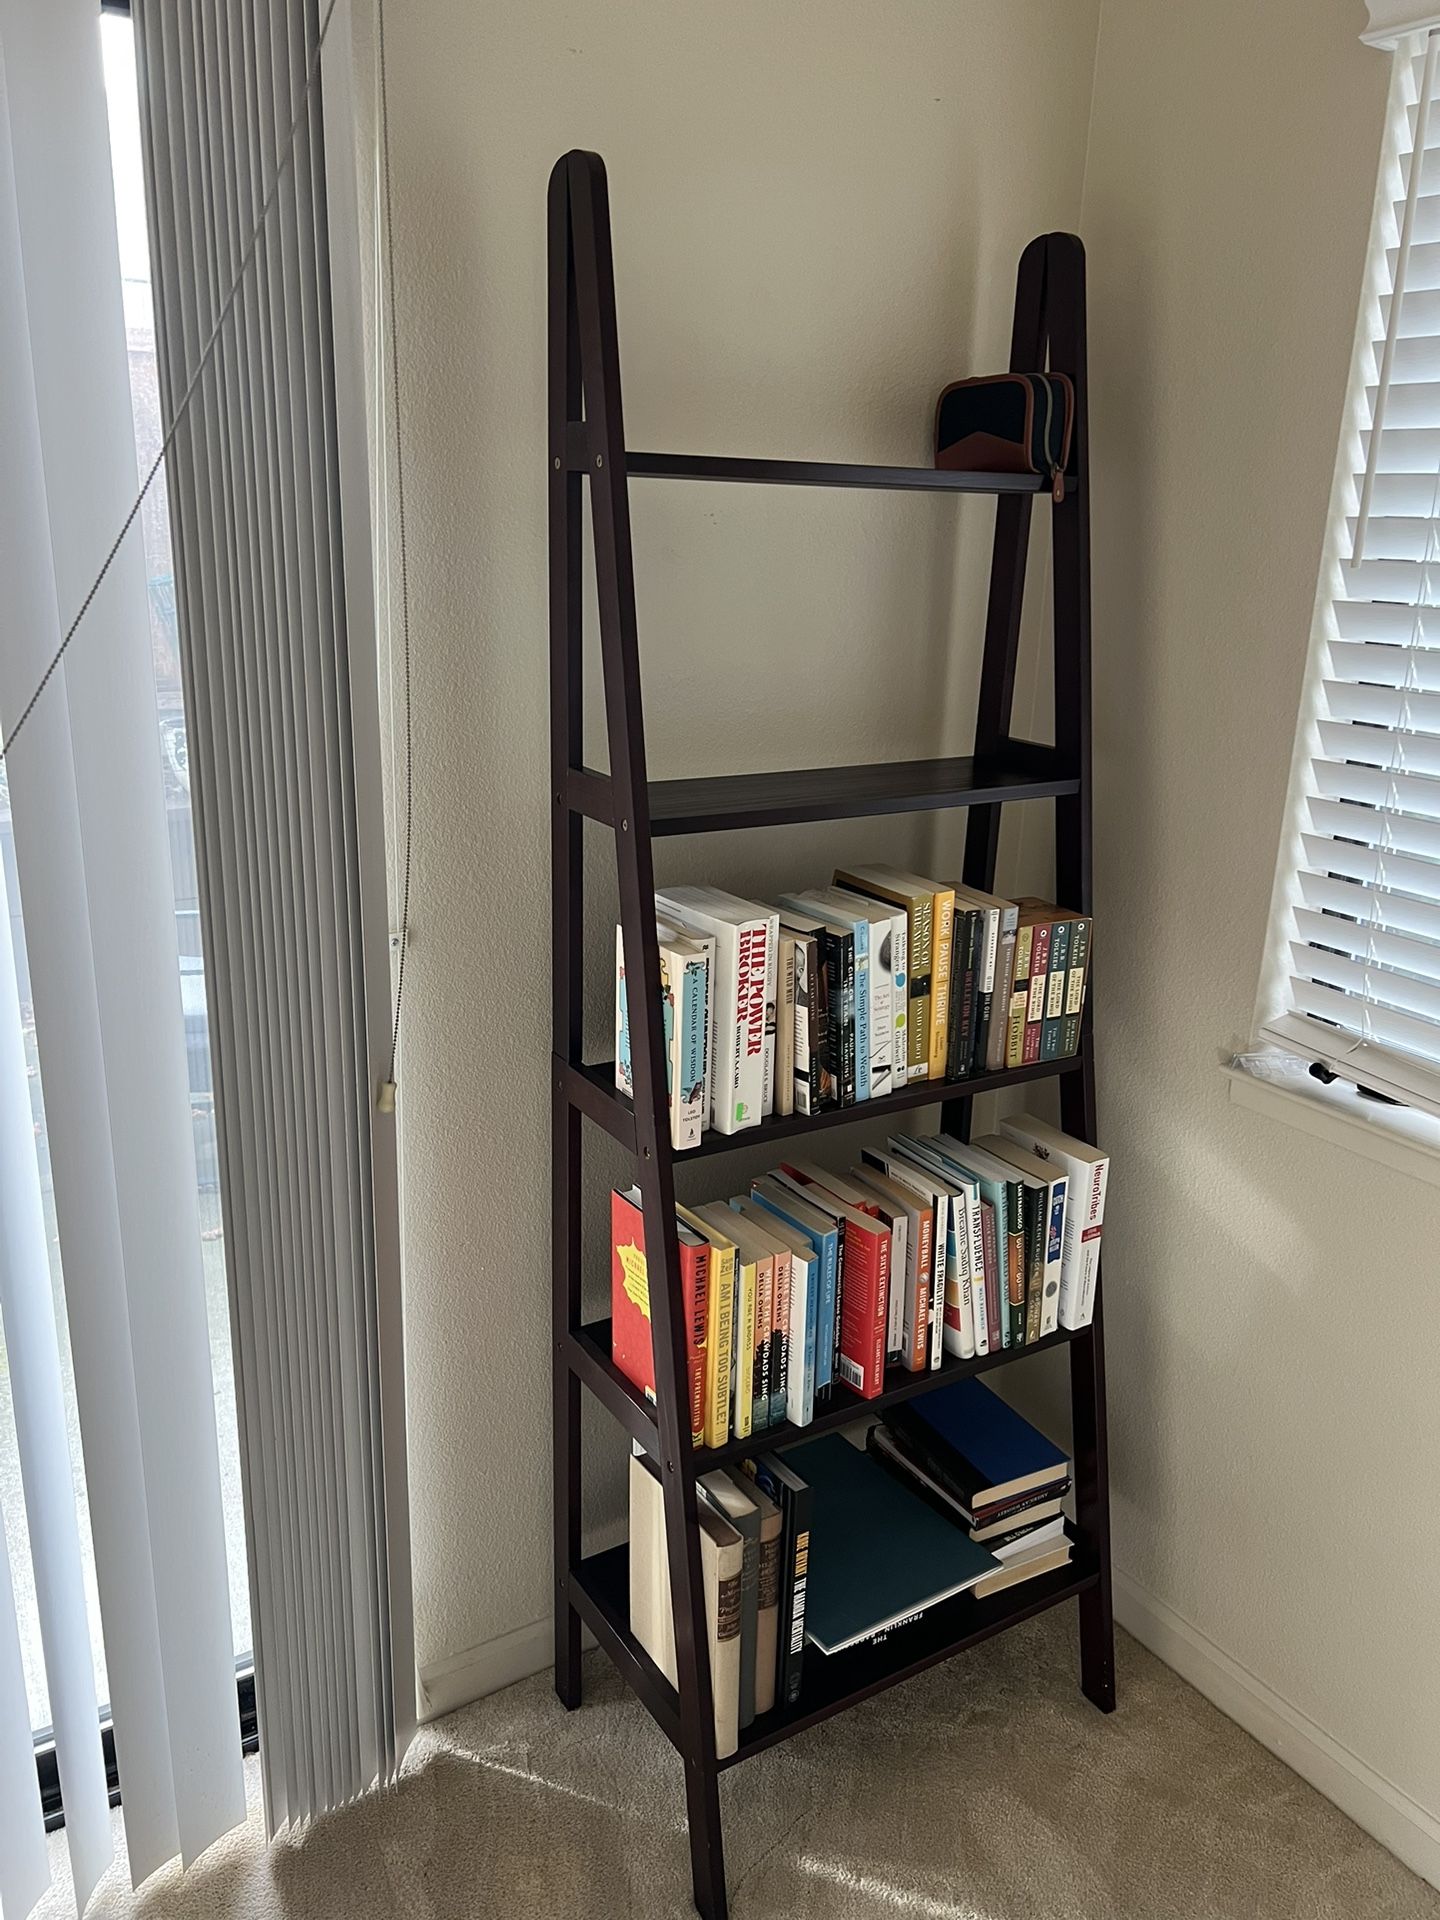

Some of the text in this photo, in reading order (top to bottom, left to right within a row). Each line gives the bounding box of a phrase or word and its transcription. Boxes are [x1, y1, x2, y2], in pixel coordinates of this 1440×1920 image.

[921, 902, 931, 967] SEASON OF
[940, 899, 952, 936] WORK
[912, 904, 922, 970] THE WITCH
[1052, 938, 1060, 969] TOLKIEN
[938, 943, 948, 978] PAUSE
[1034, 942, 1042, 973] TOLKIEN
[1072, 971, 1076, 979] OF
[737, 931, 751, 1023] BROKER
[747, 924, 766, 1056] THE POWER
[962, 971, 973, 1018] SKELETON
[1033, 978, 1038, 987] OF
[1052, 974, 1058, 983] OF
[858, 990, 866, 1020] Simple
[935, 984, 946, 1025] THRIVE
[691, 1034, 697, 1044] OF
[859, 1024, 867, 1043] Path
[860, 1046, 866, 1054] to
[1010, 1016, 1020, 1058] HOBBIT
[1089, 1164, 1104, 1220] NeuroTribes
[937, 1243, 945, 1268] WHITE
[971, 1206, 983, 1272] TRANSFLUENCE
[958, 1208, 971, 1306] Breathe Sadiq Khan
[693, 1255, 707, 1345] MICHAEL LEWIS
[720, 1284, 730, 1302] AM
[764, 1268, 772, 1301] WHERE
[825, 1280, 832, 1290] OF
[877, 1277, 886, 1317] EXTINCTION
[917, 1220, 930, 1350] MONEYBALL MICHAEL LEWIS
[936, 1270, 944, 1306] FRAGILITY
[718, 1313, 729, 1348] BEING
[780, 1318, 788, 1369] CRAWDADS
[718, 1351, 727, 1373] TOO
[761, 1325, 769, 1376] CRAWDADS
[694, 1368, 702, 1381] THE
[716, 1376, 727, 1425] SUBTLE?
[790, 1531, 809, 1655] KOBE BRYANT THE MAMBA MENTALITY
[872, 1634, 887, 1645] THE
[884, 1612, 923, 1632] FRANKLIN
